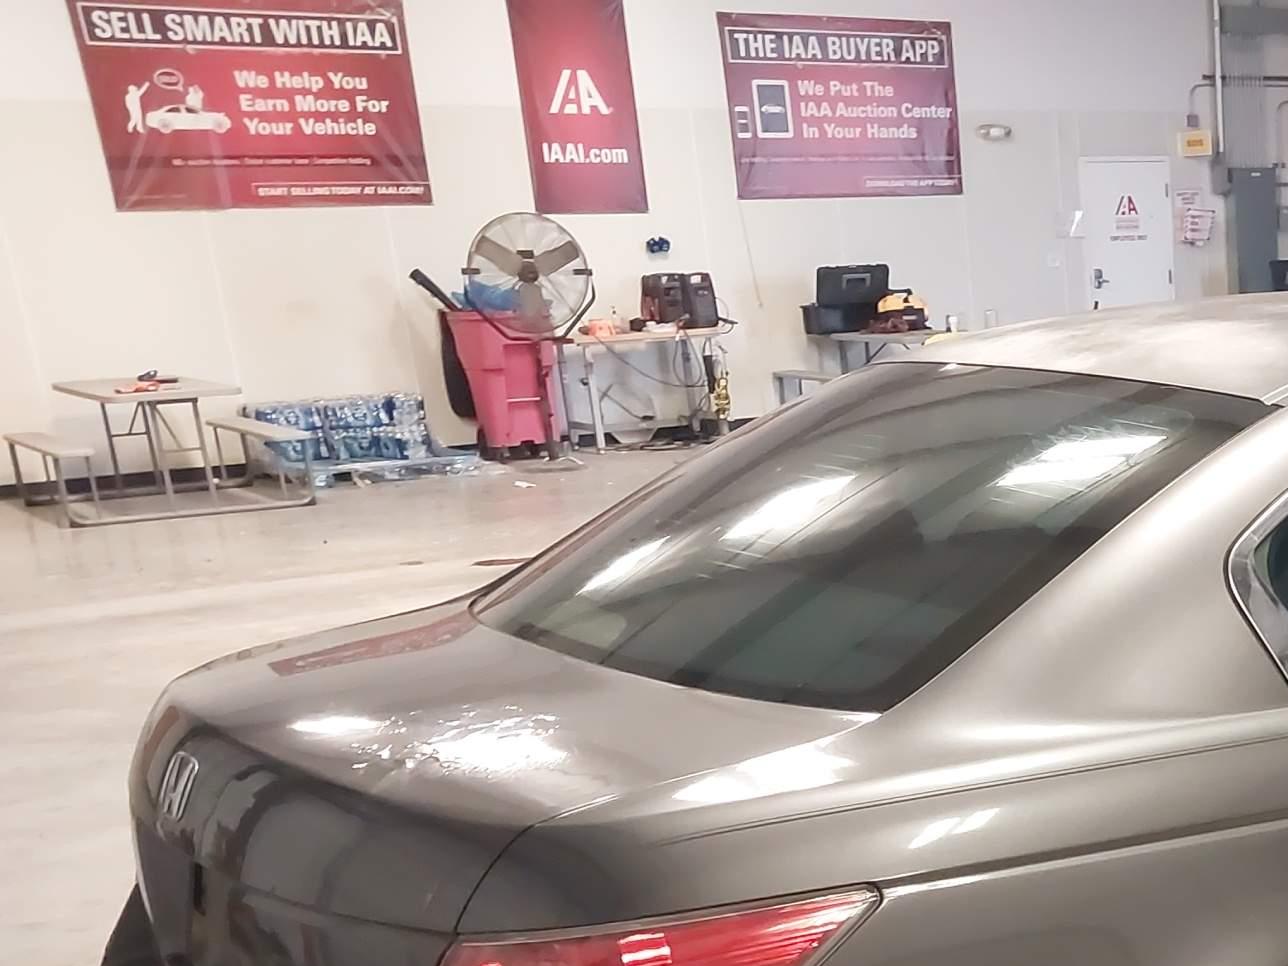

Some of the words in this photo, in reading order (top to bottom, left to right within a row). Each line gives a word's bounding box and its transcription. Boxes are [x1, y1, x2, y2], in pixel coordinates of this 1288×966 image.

[91, 10, 162, 40] SELL
[164, 13, 264, 44] SMART
[267, 18, 341, 45] WITH
[345, 21, 393, 47] IAA
[733, 33, 778, 57] THE
[782, 34, 822, 59] IAA
[827, 36, 896, 61] BUYER
[900, 39, 939, 62] APP
[233, 70, 269, 88] We
[274, 71, 324, 92] Help
[327, 72, 368, 90] You
[798, 80, 825, 96] We
[829, 81, 859, 97] Put
[863, 81, 895, 97] The
[239, 94, 290, 112] Earn
[294, 95, 350, 112] More
[355, 95, 389, 113] For
[799, 102, 832, 117] IAA
[835, 102, 898, 118] Auction
[901, 103, 952, 118] Center
[243, 117, 293, 135] Your
[298, 118, 377, 135] Vehicle
[802, 123, 820, 138] In
[823, 124, 862, 138] Your
[866, 124, 918, 139] Hands
[542, 142, 628, 164] IAAI.com
